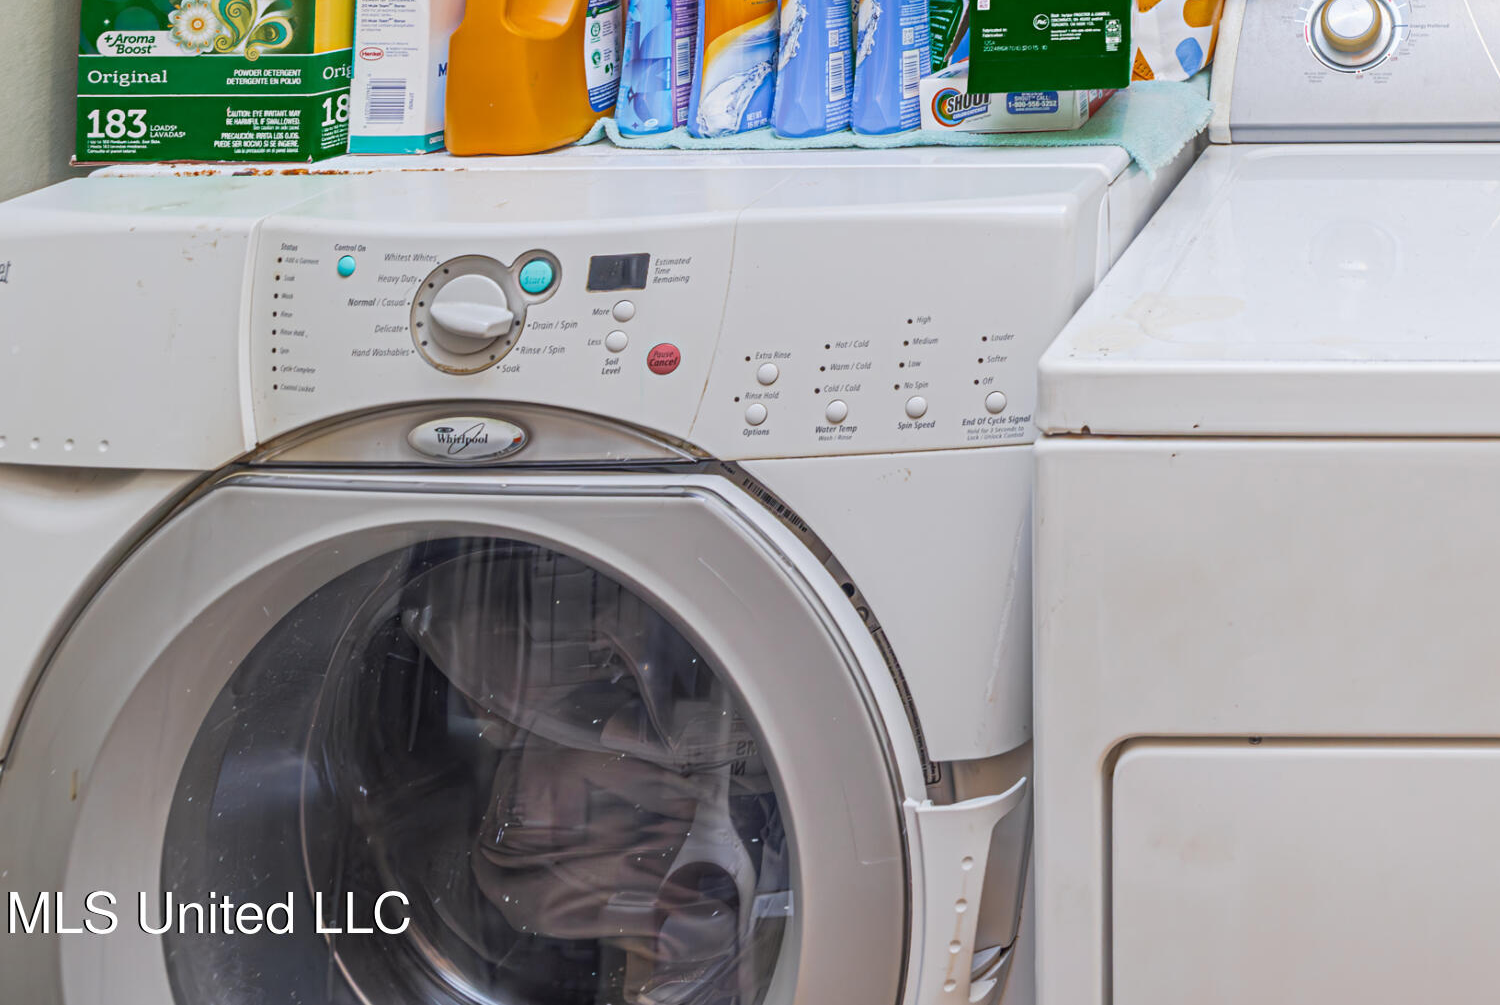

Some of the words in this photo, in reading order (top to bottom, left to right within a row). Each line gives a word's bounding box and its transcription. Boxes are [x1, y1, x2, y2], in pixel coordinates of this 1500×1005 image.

[116, 44, 152, 54] Boost
[234, 69, 262, 77] POWDER
[263, 69, 301, 77] DETERGENT
[322, 64, 352, 80] Orig
[87, 70, 168, 87] Original
[87, 108, 147, 138] 183
[334, 244, 356, 252] Control
[384, 253, 411, 262] Whitest
[412, 254, 437, 262] Whites
[655, 257, 692, 265] Estimated
[378, 275, 399, 284] Heavy
[400, 276, 418, 285] Duty
[652, 275, 690, 284] Remaining
[348, 298, 376, 306] Normal
[382, 298, 406, 306] Casual
[916, 316, 931, 324] High
[374, 324, 403, 333] Delicate
[532, 322, 553, 330] Drain
[560, 320, 578, 331] Spin
[351, 348, 370, 356] Hand
[372, 348, 409, 356] Washables
[520, 346, 541, 354] Rinse
[548, 345, 565, 355] Spin
[605, 358, 619, 366] Soil
[650, 358, 677, 367] Cancel
[502, 364, 520, 373] Soak
[602, 366, 621, 375] Level
[915, 382, 928, 390] Spin
[898, 421, 913, 430] Spin
[915, 420, 936, 430] Speed
[988, 417, 1006, 427] Cycle
[1009, 415, 1031, 425] Signal
[742, 428, 770, 437] Options
[838, 425, 857, 434] Temp
[437, 434, 488, 444] Whirlpool
